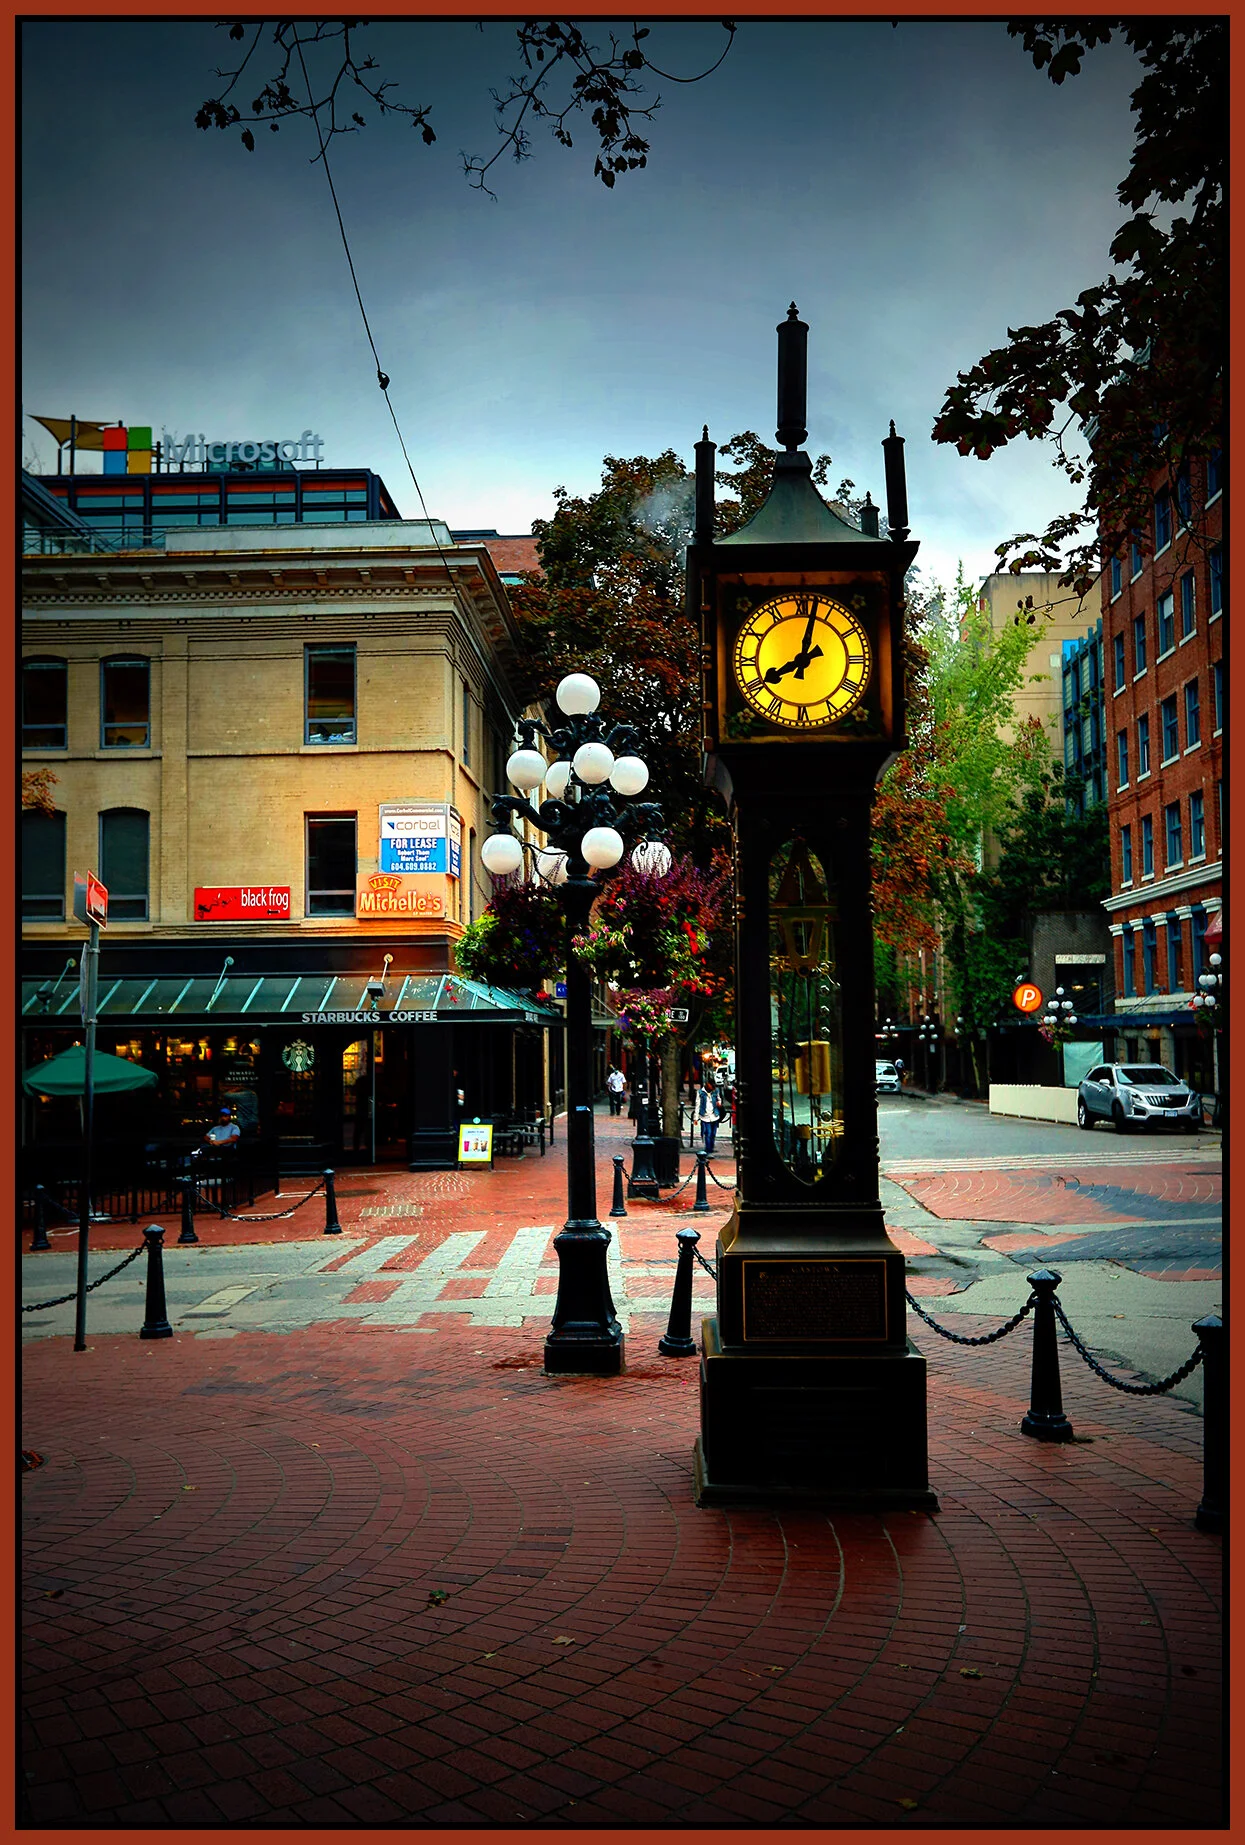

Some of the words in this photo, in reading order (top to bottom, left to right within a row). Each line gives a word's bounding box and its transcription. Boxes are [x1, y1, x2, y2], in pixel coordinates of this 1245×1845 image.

[163, 429, 324, 464] Microsoft
[848, 655, 864, 664] III
[396, 820, 440, 831] corbel
[390, 838, 408, 849] FOR
[410, 838, 438, 849] LEASE
[370, 877, 400, 889] VISIT
[241, 888, 267, 907] black
[269, 888, 289, 910] frog
[360, 890, 441, 911] Michelle's
[1022, 989, 1036, 1007] P
[302, 1011, 380, 1023] STARBUCKS
[389, 1010, 437, 1022] COFFEE
